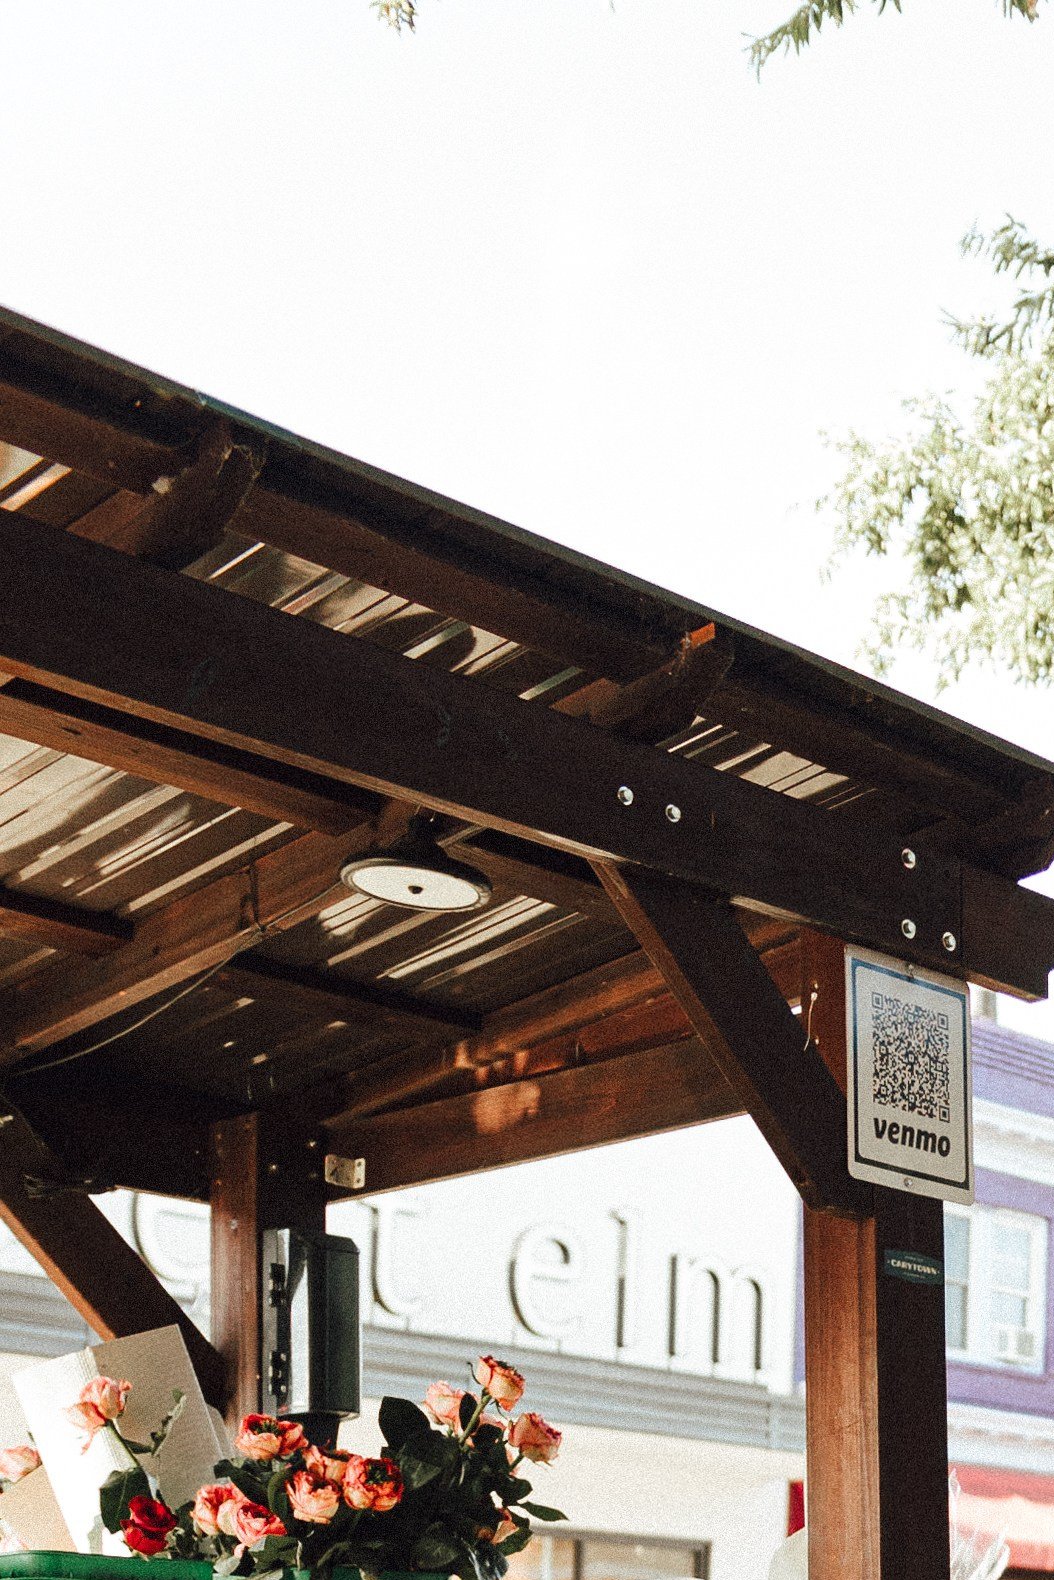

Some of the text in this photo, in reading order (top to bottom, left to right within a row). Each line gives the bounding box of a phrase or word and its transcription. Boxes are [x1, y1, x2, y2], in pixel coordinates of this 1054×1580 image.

[872, 1116, 951, 1158] venmo
[890, 1258, 937, 1275] CARYTOWN
[507, 1204, 773, 1372] elm
